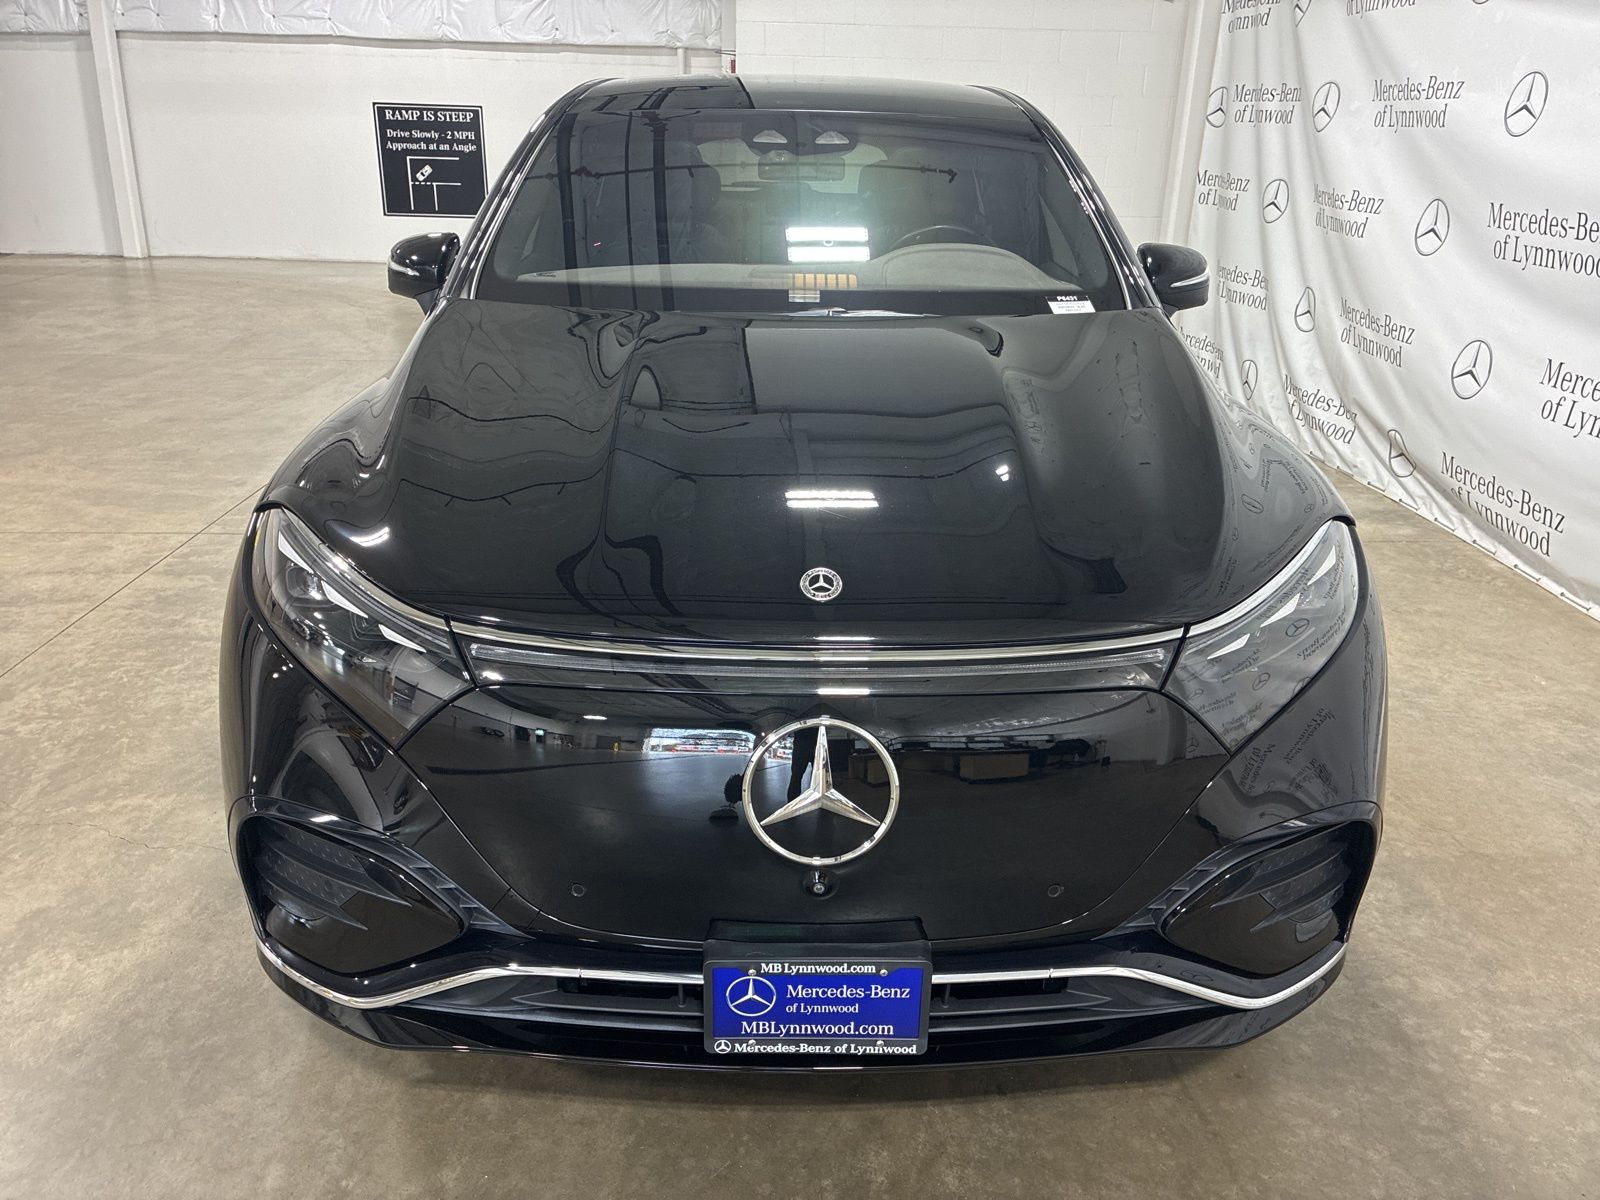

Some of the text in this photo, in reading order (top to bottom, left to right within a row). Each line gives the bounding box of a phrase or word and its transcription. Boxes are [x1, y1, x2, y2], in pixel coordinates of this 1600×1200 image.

[1355, 0, 1416, 19] Lynnwoo
[1372, 75, 1465, 102] Mercedes-Benz
[384, 109, 474, 122] RAMP IS STEEP
[1234, 104, 1249, 123] of
[1373, 103, 1448, 134] of Lynnwood
[386, 129, 410, 138] Drive
[411, 129, 439, 140] Slowly
[446, 131, 452, 139] 2
[454, 131, 475, 140] MPH
[386, 141, 427, 151] Approach
[428, 143, 437, 151] at
[451, 143, 477, 153] Angle
[1198, 188, 1213, 205] of
[1487, 202, 1600, 245] Mercedes-Be
[1493, 234, 1511, 260] of
[1340, 297, 1416, 345] Mercedes-Benz
[1340, 324, 1402, 368] of Lynnwood
[1541, 396, 1566, 422] of
[1441, 451, 1566, 534] Mercedes-Benz
[1466, 490, 1550, 557] Lynnwood
[761, 963, 876, 975] MB Lynnwood.com
[786, 984, 911, 999] Mercedes-Benz
[786, 1003, 859, 1015] of Lynnwood
[741, 1021, 894, 1037] MBLynnwood.com
[734, 1043, 917, 1055] Mercedes-Benz of Lynnwood
